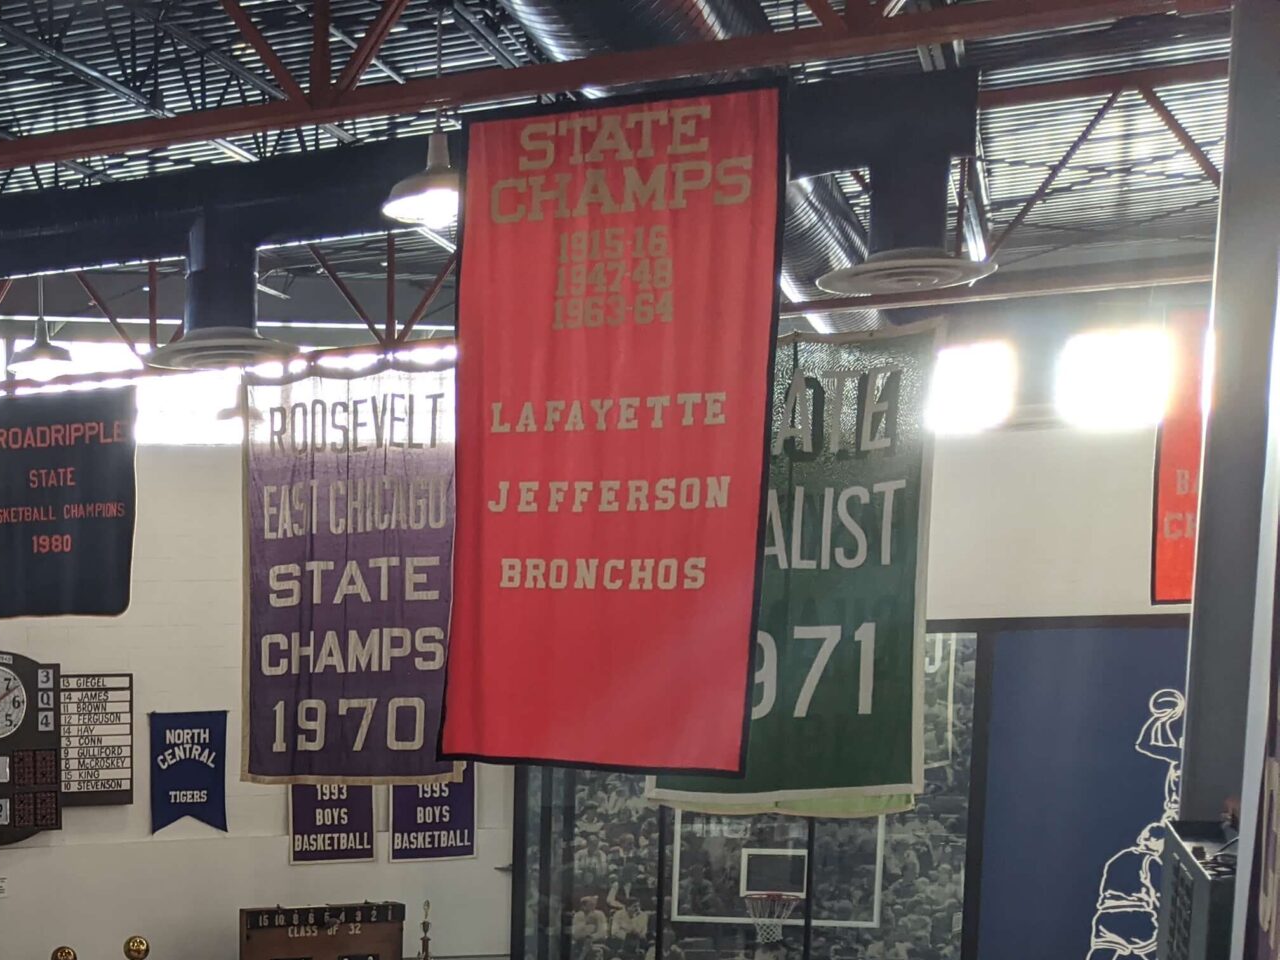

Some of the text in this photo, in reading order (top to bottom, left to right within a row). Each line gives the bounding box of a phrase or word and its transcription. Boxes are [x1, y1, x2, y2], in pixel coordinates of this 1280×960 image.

[519, 105, 711, 171] STATE
[490, 155, 753, 224] CHAMPS
[558, 225, 667, 263] 1915-16
[491, 392, 726, 433] LAFAYETTE
[269, 393, 445, 456] ROOSEVELT
[30, 467, 76, 488] STATE
[488, 476, 730, 513] JEFFERSON
[64, 503, 125, 519] CHAMPIONS
[264, 476, 446, 540] EAST CHICAGO
[32, 535, 72, 552] 1980
[500, 557, 706, 590] BRONCHOS
[268, 556, 440, 608] STATE
[261, 627, 445, 676] CHAMPS
[41, 671, 50, 683] 3
[77, 678, 106, 688] GIEGEL
[41, 693, 50, 706] Q
[77, 692, 108, 701] JAMES
[77, 703, 106, 712] BROWN
[41, 714, 50, 727] 4
[77, 714, 120, 724] FERGUSON
[272, 697, 425, 753] 1970
[78, 737, 102, 745] CONN
[166, 728, 209, 744] NORTH
[77, 748, 122, 757] GULLIFORD
[157, 744, 216, 769] CENTRAL
[78, 758, 125, 769] McCROSKEY
[79, 771, 100, 779] KING
[77, 782, 122, 790] STEVENSON
[316, 784, 347, 800] 1993
[418, 782, 449, 798] 1995
[169, 791, 207, 803] TIGERS
[316, 808, 348, 825] BOYS
[416, 805, 450, 823] BOYS
[295, 832, 371, 851] BASKETBALL
[394, 830, 471, 849] BASKETBALL
[288, 925, 318, 937] CLASS
[349, 923, 361, 934] 32
